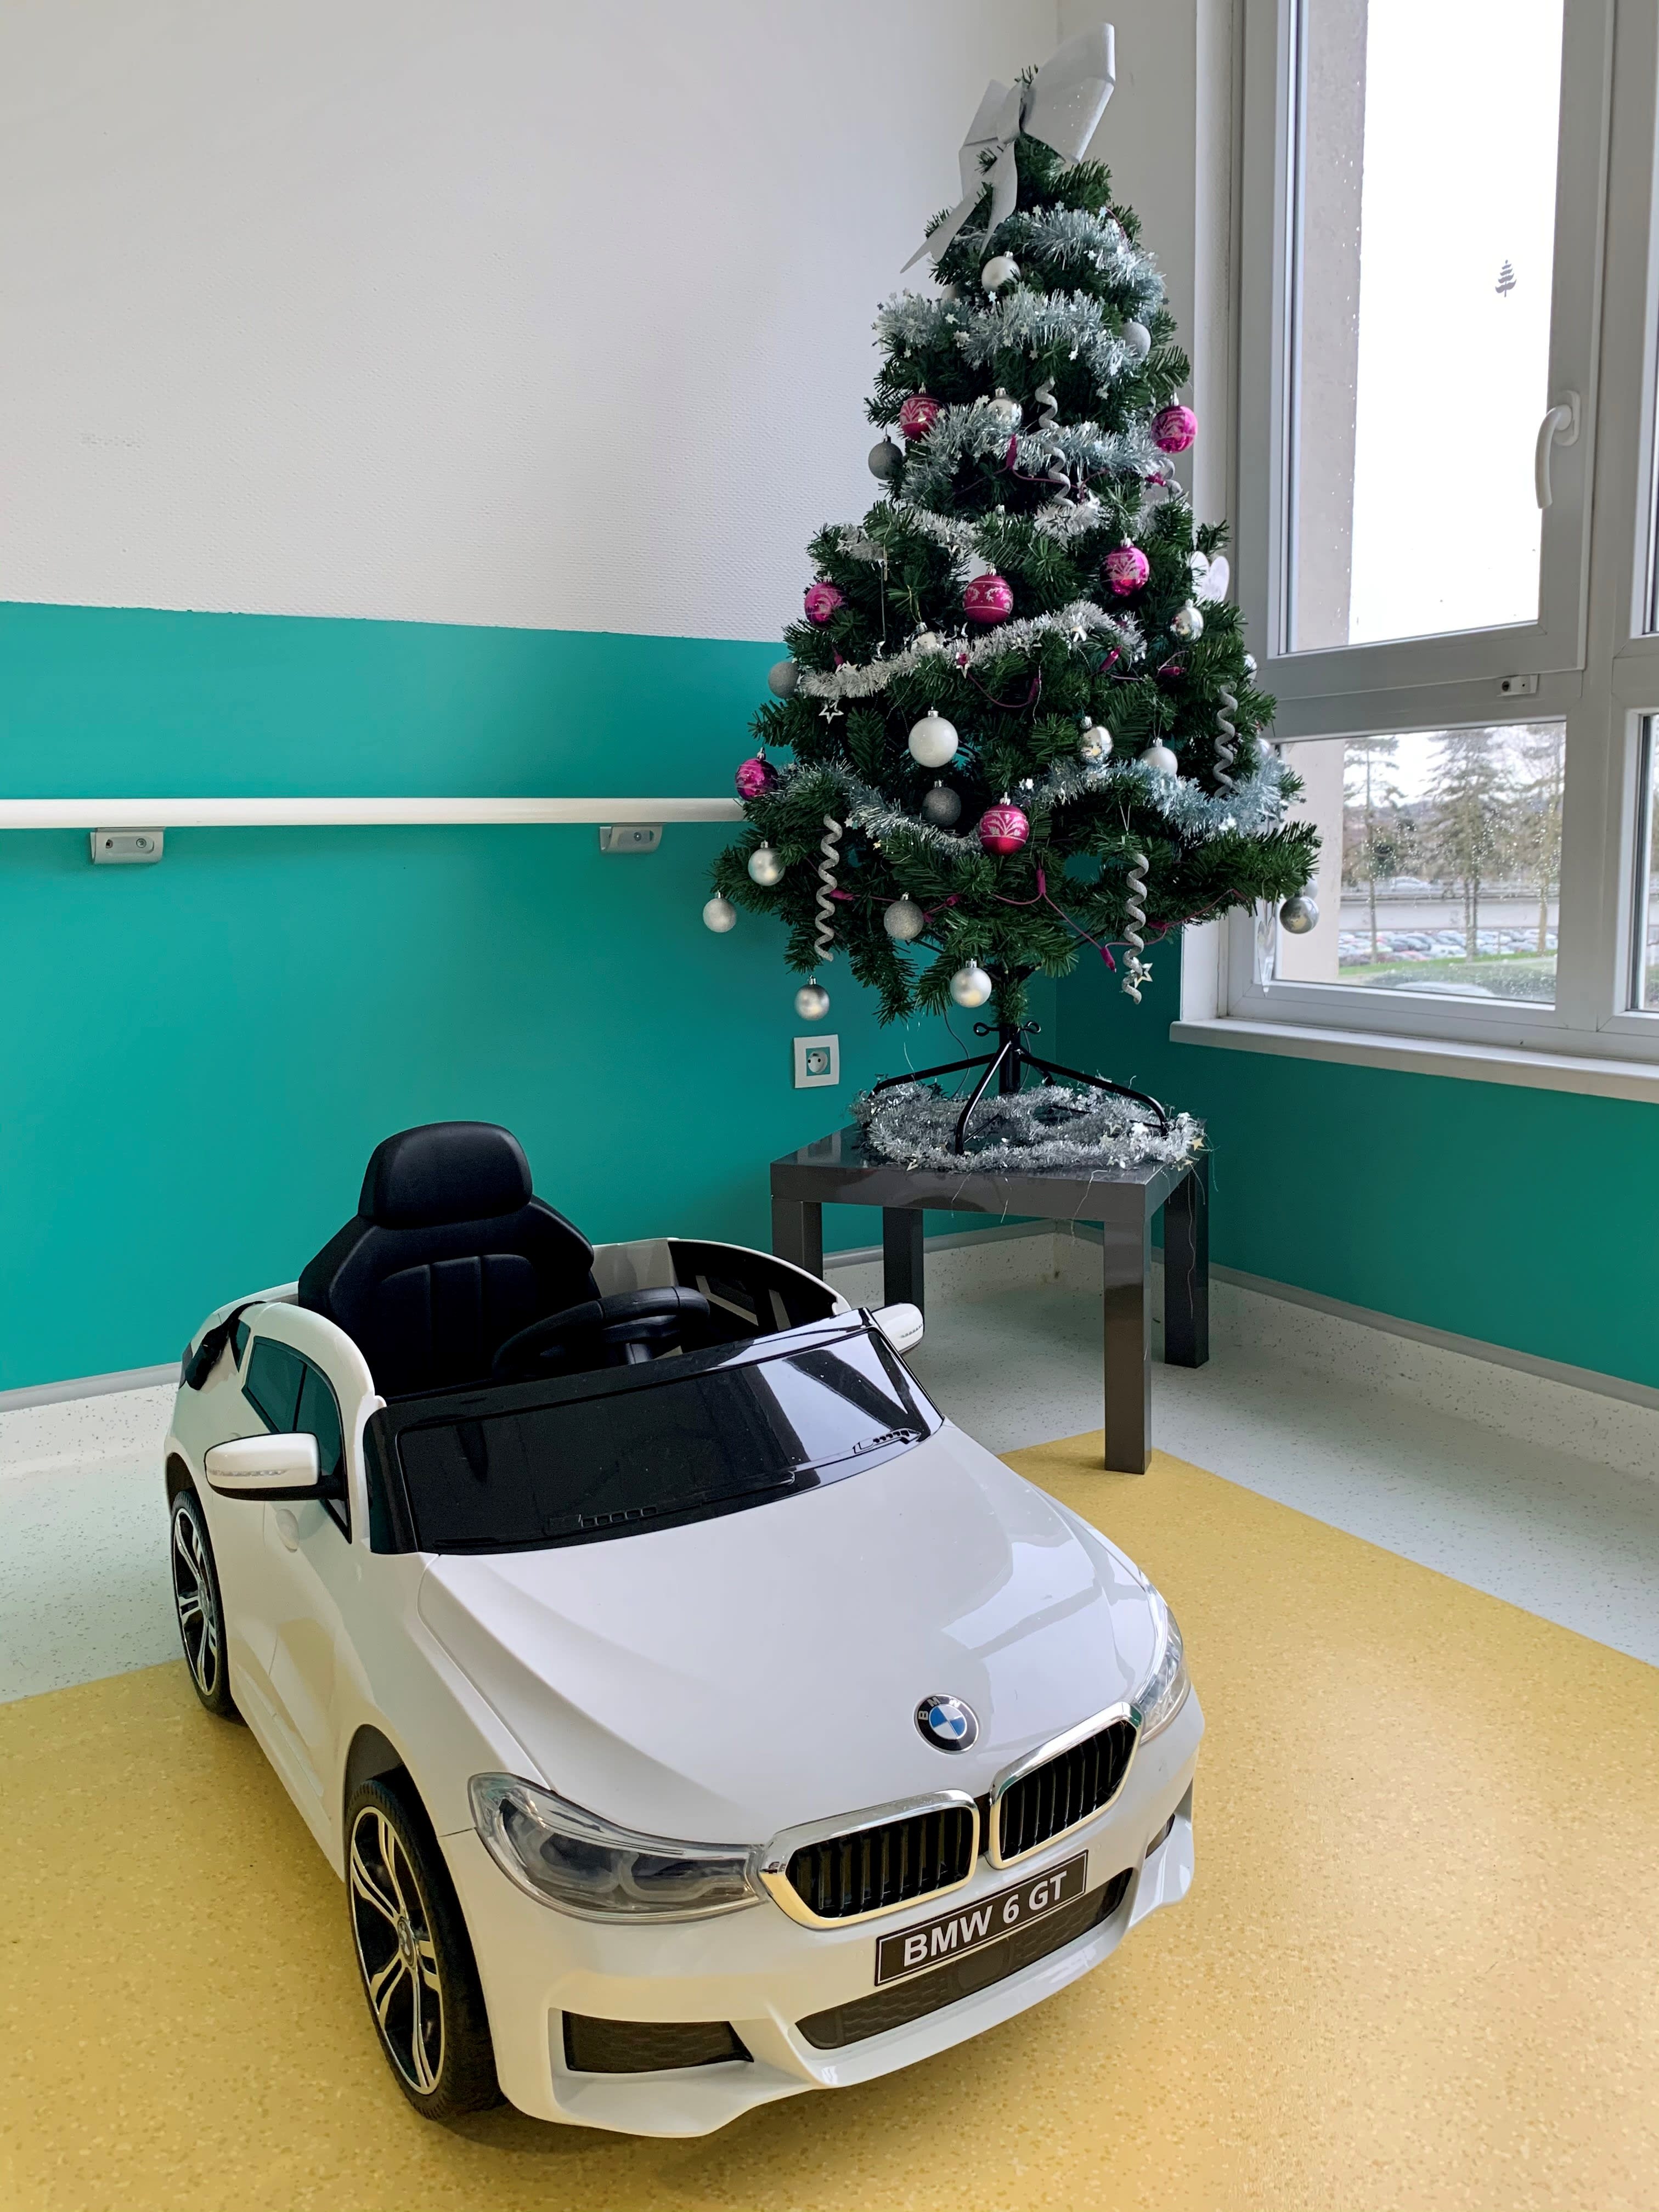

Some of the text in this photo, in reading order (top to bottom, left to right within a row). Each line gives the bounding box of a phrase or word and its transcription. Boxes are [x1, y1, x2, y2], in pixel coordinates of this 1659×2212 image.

[918, 1696, 961, 1720] BMW
[903, 1870, 1067, 1967] BMW 6 GT
